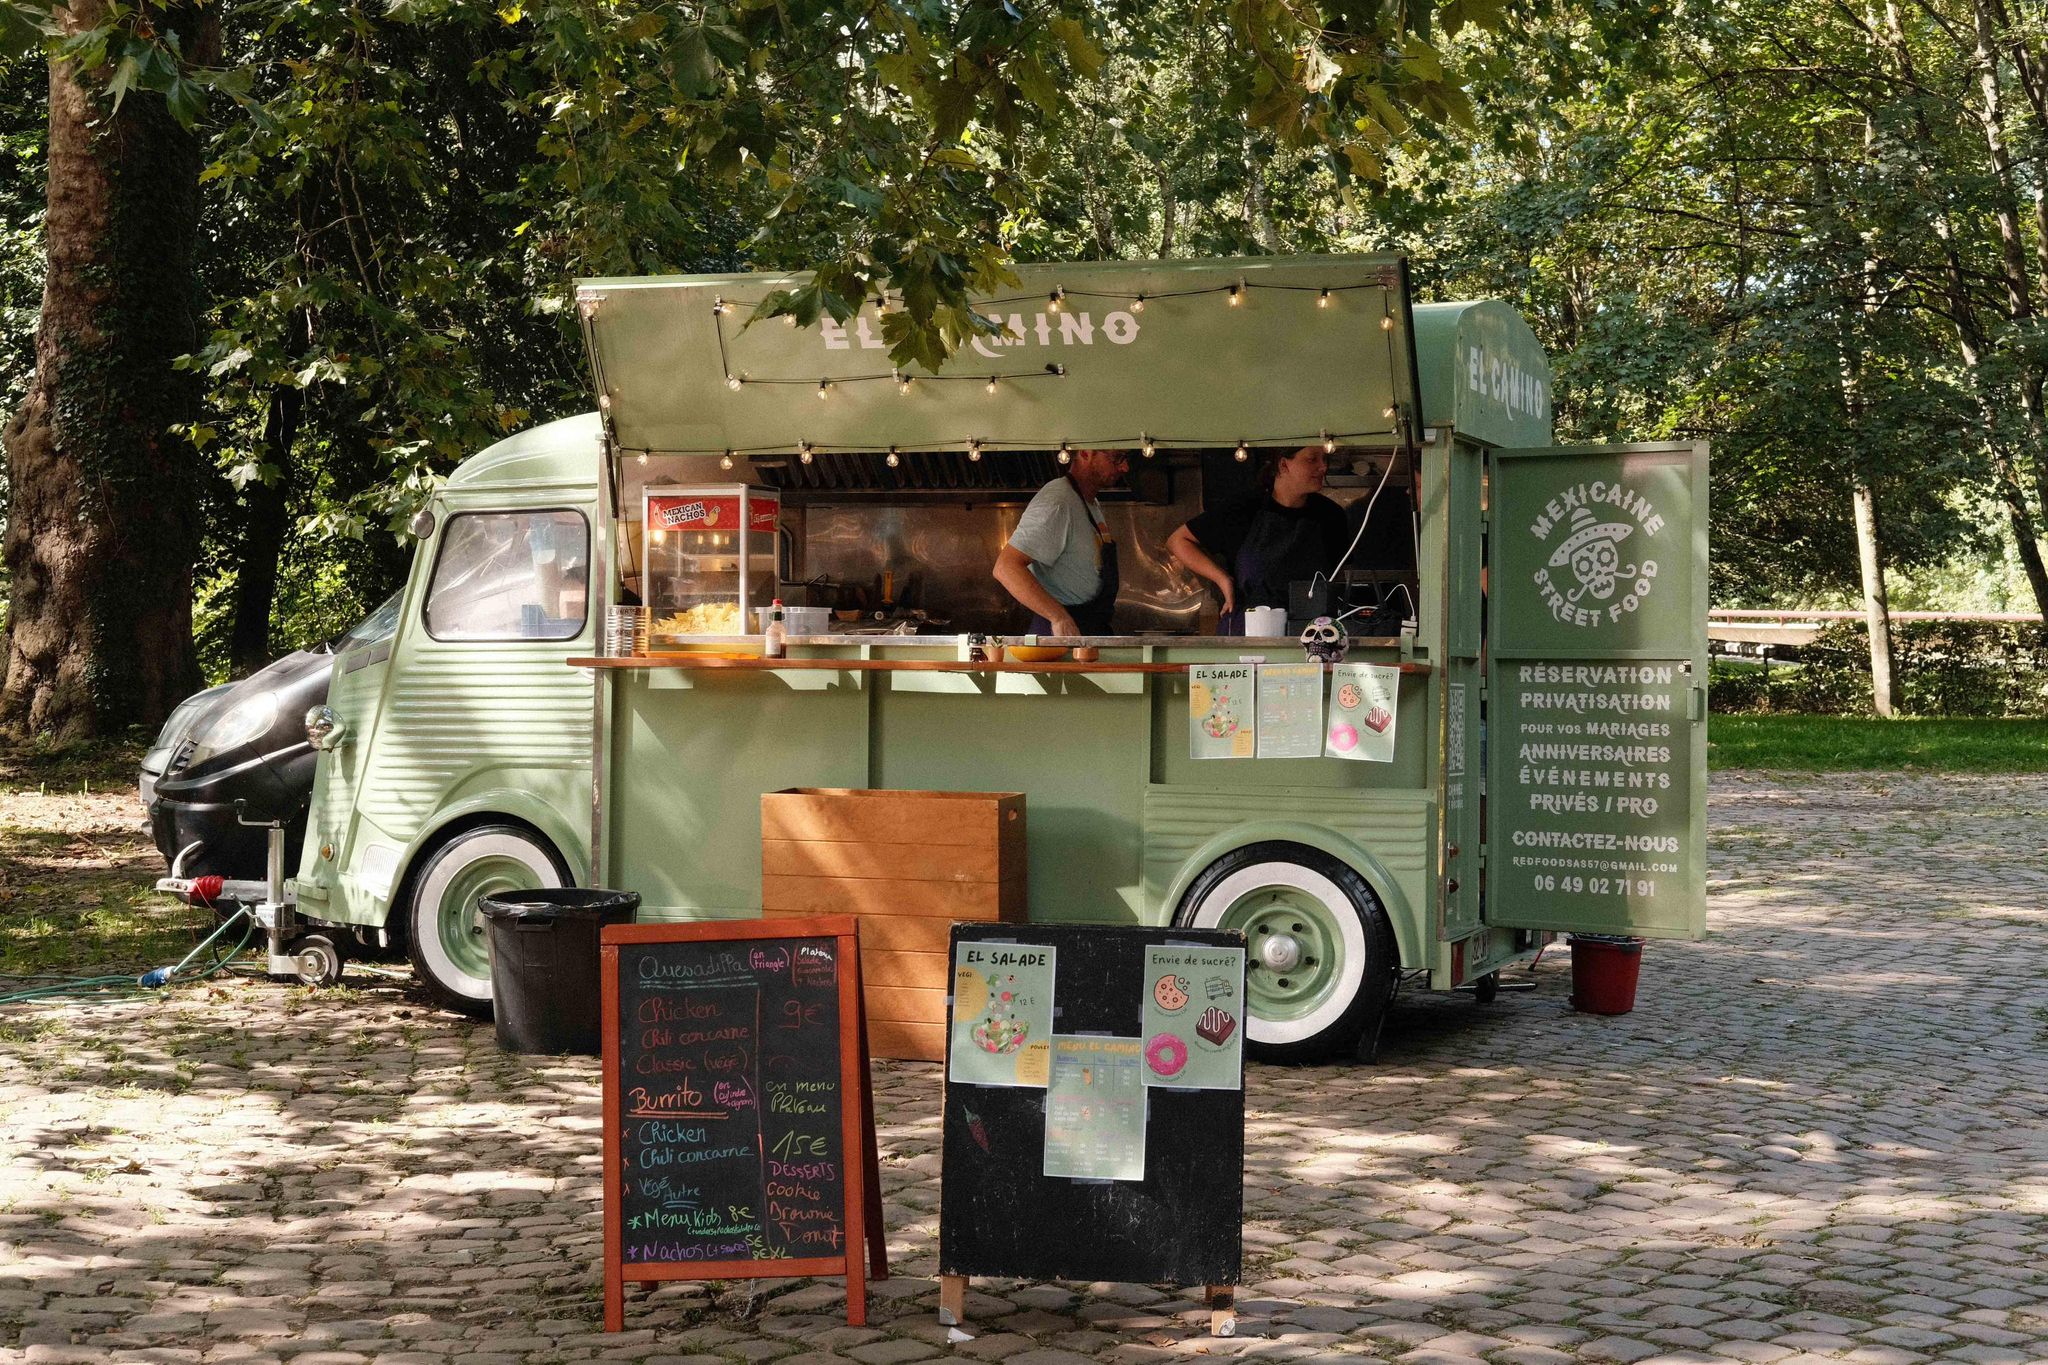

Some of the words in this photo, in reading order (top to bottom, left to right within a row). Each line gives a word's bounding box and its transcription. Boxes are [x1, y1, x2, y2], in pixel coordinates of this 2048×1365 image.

[820, 317, 885, 350] EL
[1469, 347, 1487, 395] EL
[1491, 362, 1544, 421] CAMINO
[663, 502, 702, 518] MEXICAN
[667, 509, 706, 524] NACHOS
[1530, 481, 1665, 540] MEXICAINE
[1533, 568, 1601, 627] STREET
[1608, 560, 1658, 624] FOOD
[1196, 670, 1208, 679] EL
[1212, 669, 1248, 679] SALADE
[1337, 670, 1356, 678] Envie
[1519, 662, 1672, 688] RÉSERVATION
[1520, 693, 1670, 714] PRIVATISATION
[1520, 723, 1553, 734] POUR
[1557, 724, 1581, 735] VOS
[1586, 722, 1671, 740] MARIAGES
[1519, 743, 1671, 767] ANNIVERSAIRES
[1519, 765, 1671, 789] ÉVÉNEMENTS
[1529, 791, 1600, 815] PRIVÉS
[1616, 797, 1659, 818] PRO
[1512, 830, 1679, 853] CONTACTEZ-NOUS
[1534, 874, 1555, 892] 06
[1561, 876, 1583, 893] 49
[1589, 877, 1609, 894] 02
[1615, 879, 1632, 896] 71
[1637, 880, 1656, 897] 91
[639, 953, 750, 979] Quesadilla
[967, 950, 985, 963] EL
[990, 952, 1046, 967] SALADE
[1152, 954, 1180, 965] Envie
[1184, 955, 1197, 965] de
[1201, 956, 1237, 967] sucré?
[639, 997, 722, 1023] Chicken
[637, 1055, 697, 1074] Classic
[629, 1076, 703, 1110] Burrito
[796, 1081, 835, 1093] menu
[638, 1121, 706, 1145] Chicken
[640, 1147, 674, 1169] Chili
[768, 1161, 835, 1180] DESSERTS
[767, 1182, 821, 1200] Cookie
[644, 1208, 693, 1229] Menu
[693, 1207, 722, 1227] Kids
[770, 1201, 841, 1221] Brownie
[779, 1222, 844, 1250] Donut
[644, 1241, 704, 1261] Nachos
